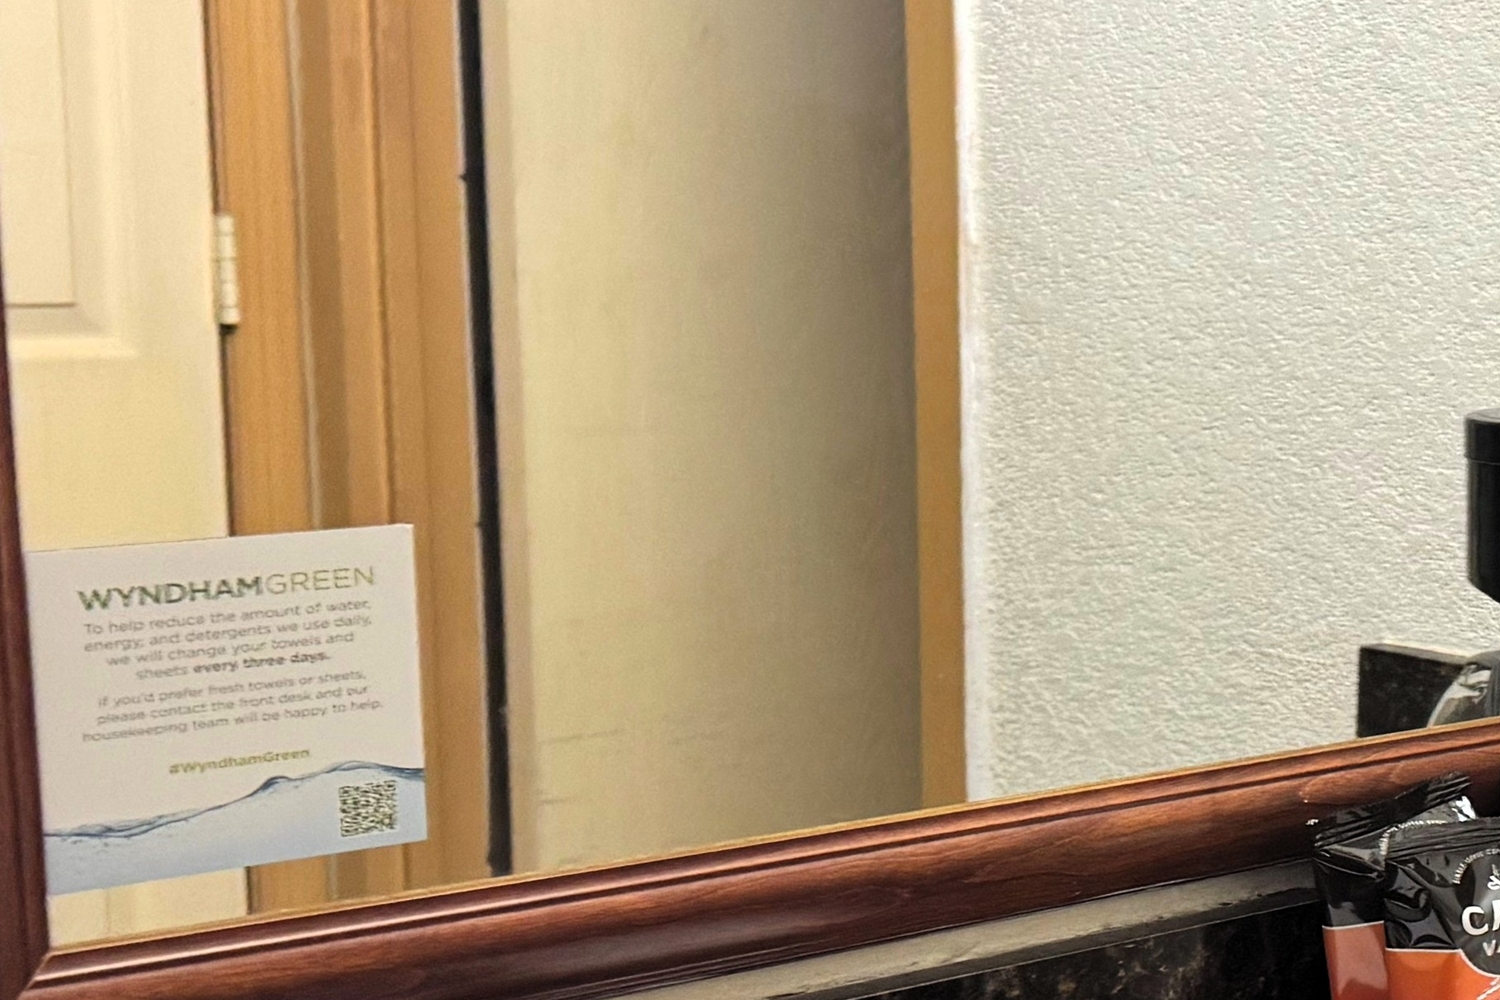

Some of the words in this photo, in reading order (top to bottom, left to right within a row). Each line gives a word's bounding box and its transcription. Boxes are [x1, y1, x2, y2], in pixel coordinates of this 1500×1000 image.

[84, 623, 103, 634] To
[108, 620, 145, 634] help
[149, 615, 205, 629] reduce
[210, 613, 236, 624] the
[240, 606, 300, 620] amount
[305, 602, 322, 614] of
[149, 633, 181, 645] and
[185, 625, 271, 643] detergents
[277, 621, 298, 633] we
[303, 620, 330, 631] use
[106, 655, 131, 666] we
[136, 651, 163, 663] will
[167, 646, 226, 661] change
[231, 642, 267, 656] your
[271, 636, 322, 649] towels
[326, 632, 354, 644] and
[136, 666, 188, 680] sheets
[193, 660, 238, 673] every
[243, 656, 285, 668] three
[97, 711, 146, 725] please
[151, 703, 207, 718] contact
[211, 701, 235, 711] the
[239, 696, 275, 707] front
[278, 691, 312, 704] desk
[316, 687, 342, 699] and
[346, 686, 368, 696] our
[98, 696, 109, 707] If
[158, 688, 203, 702] prefer
[208, 683, 244, 695] fresh
[248, 678, 294, 691] towels
[299, 676, 314, 686] or
[82, 721, 188, 742] housekeeping
[193, 717, 229, 731] team
[235, 711, 257, 724] will
[261, 710, 280, 721] be
[283, 706, 328, 719] happy
[332, 703, 346, 713] to
